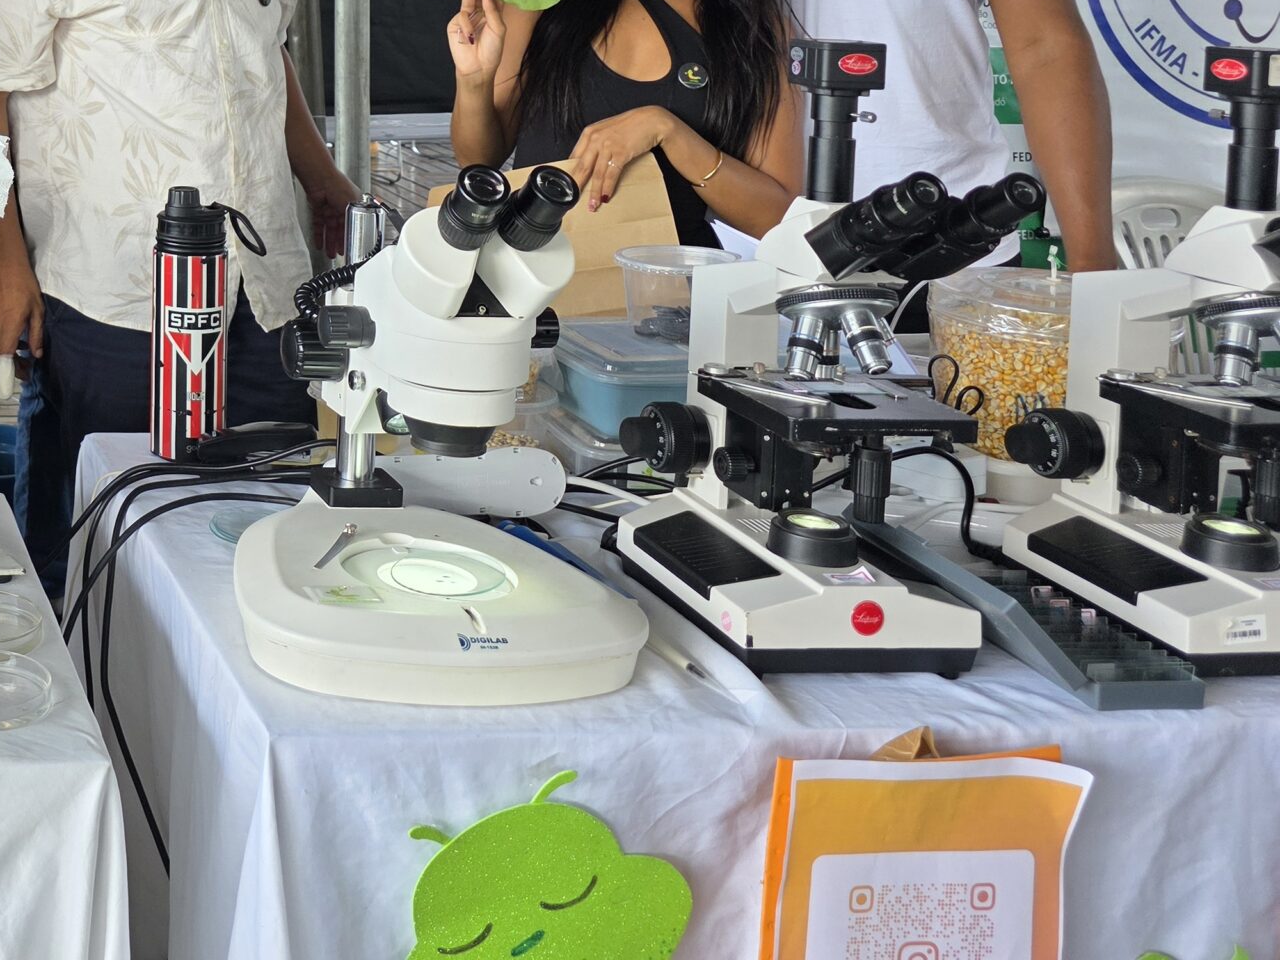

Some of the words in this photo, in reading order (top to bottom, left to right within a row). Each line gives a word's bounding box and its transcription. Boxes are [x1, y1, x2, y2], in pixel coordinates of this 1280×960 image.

[1134, 18, 1187, 75] IFMA
[170, 313, 220, 328] SPFC
[469, 636, 509, 644] DIGILAB
